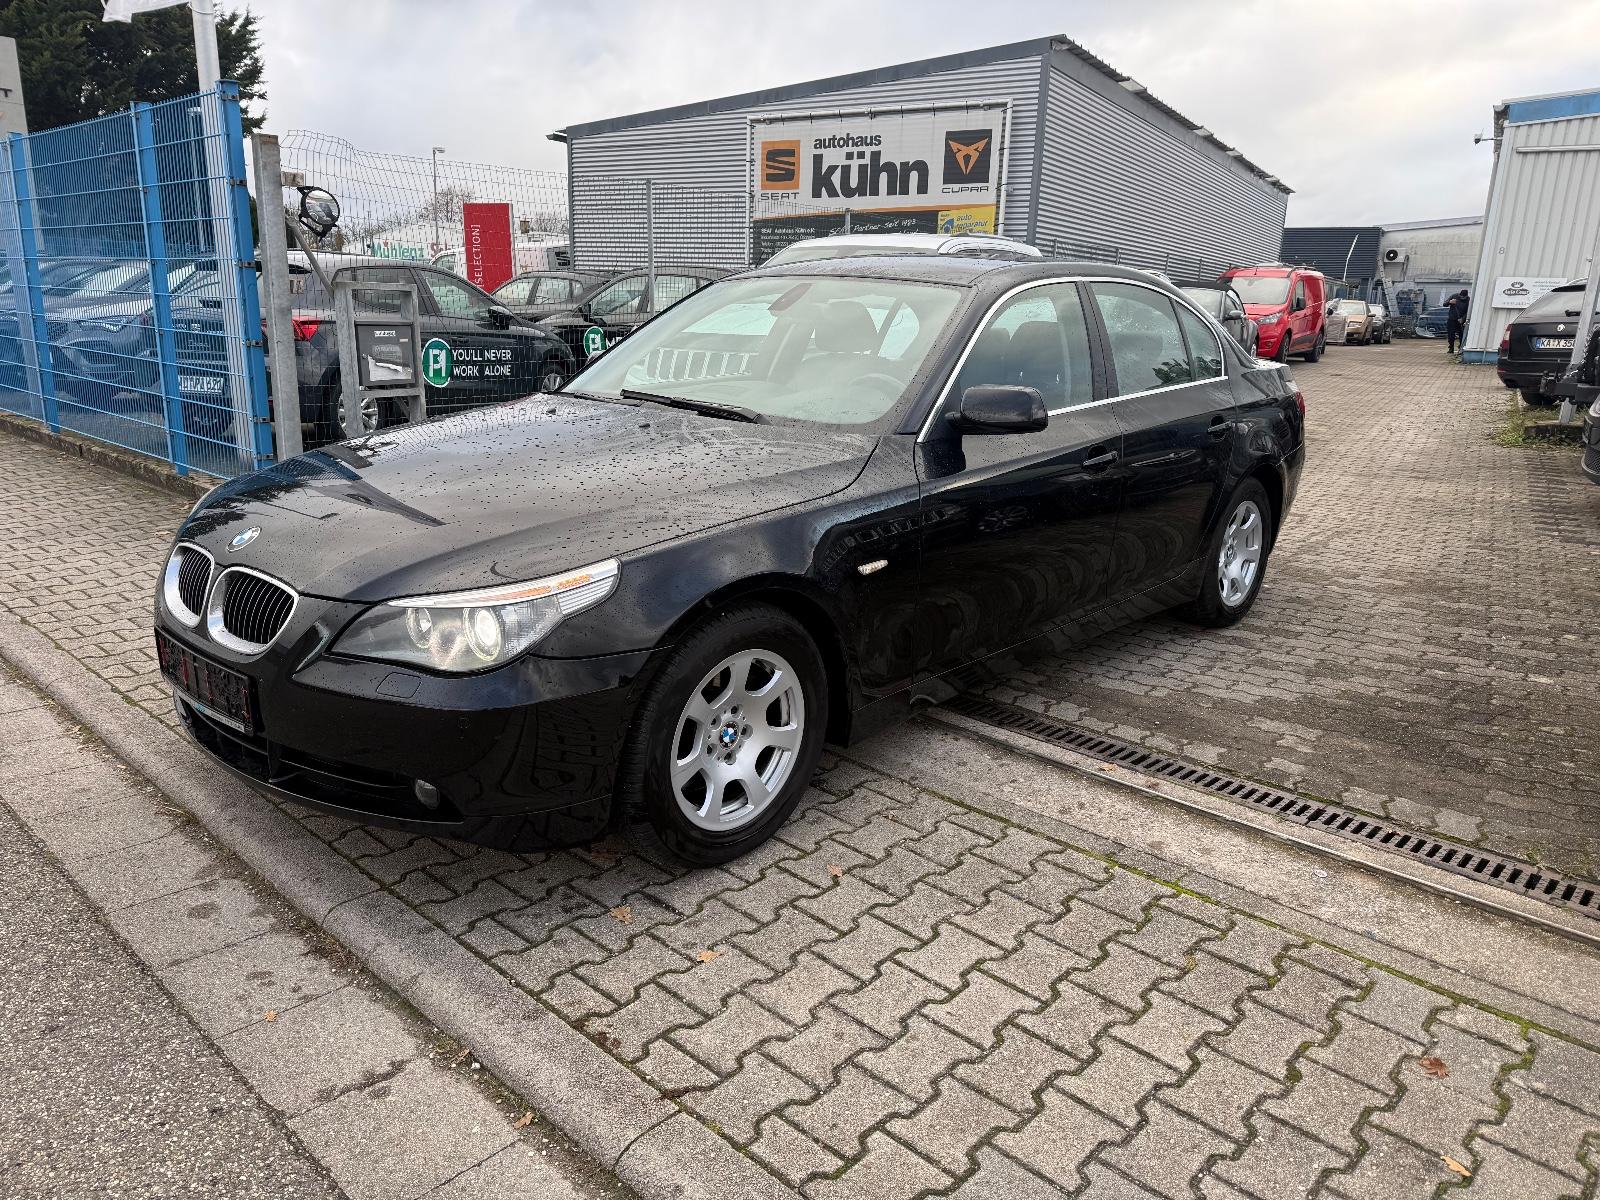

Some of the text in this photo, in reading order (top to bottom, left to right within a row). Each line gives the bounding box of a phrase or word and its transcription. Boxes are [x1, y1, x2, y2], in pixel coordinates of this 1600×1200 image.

[813, 133, 882, 149] autohaus
[811, 149, 929, 199] kühn
[760, 192, 800, 200] SEAT
[941, 186, 989, 194] CUPRA
[452, 349, 512, 361] YOU'LL NEVER
[453, 364, 512, 377] WORK ALONE
